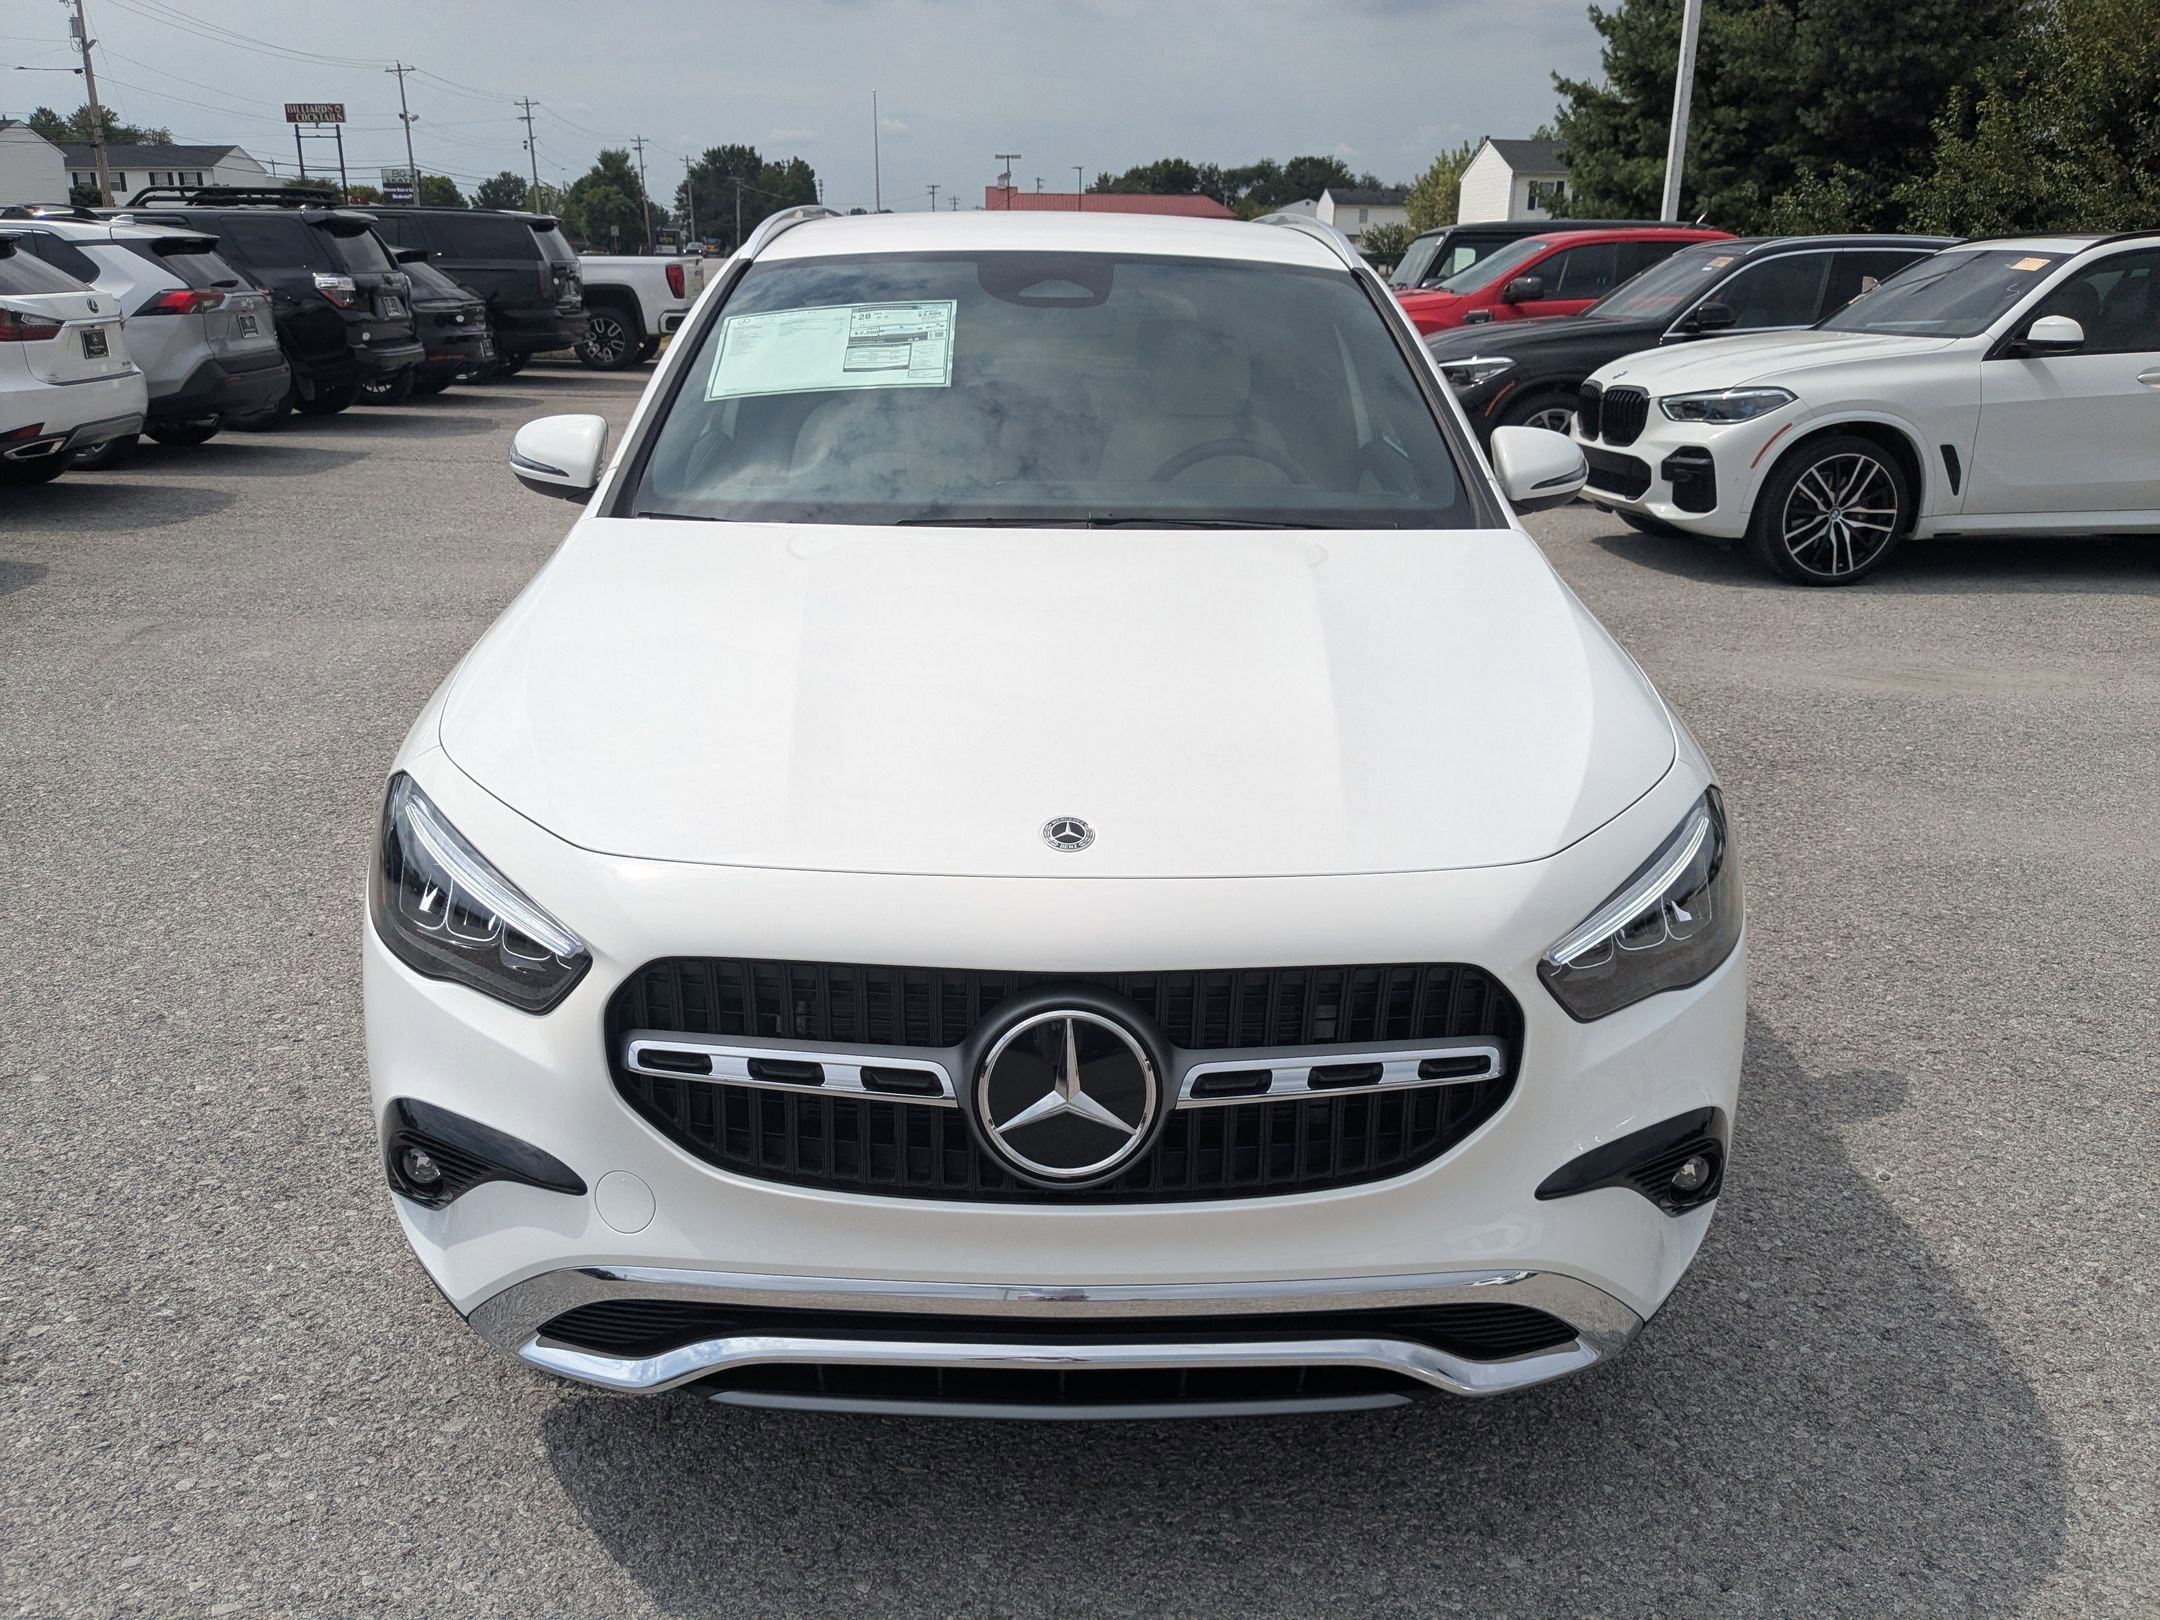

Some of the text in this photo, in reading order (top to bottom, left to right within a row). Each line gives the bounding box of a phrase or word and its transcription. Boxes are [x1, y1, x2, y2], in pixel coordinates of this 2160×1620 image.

[287, 104, 333, 113] BILLIARDS
[296, 113, 344, 121] COCKTAILS
[858, 312, 872, 321] 28
